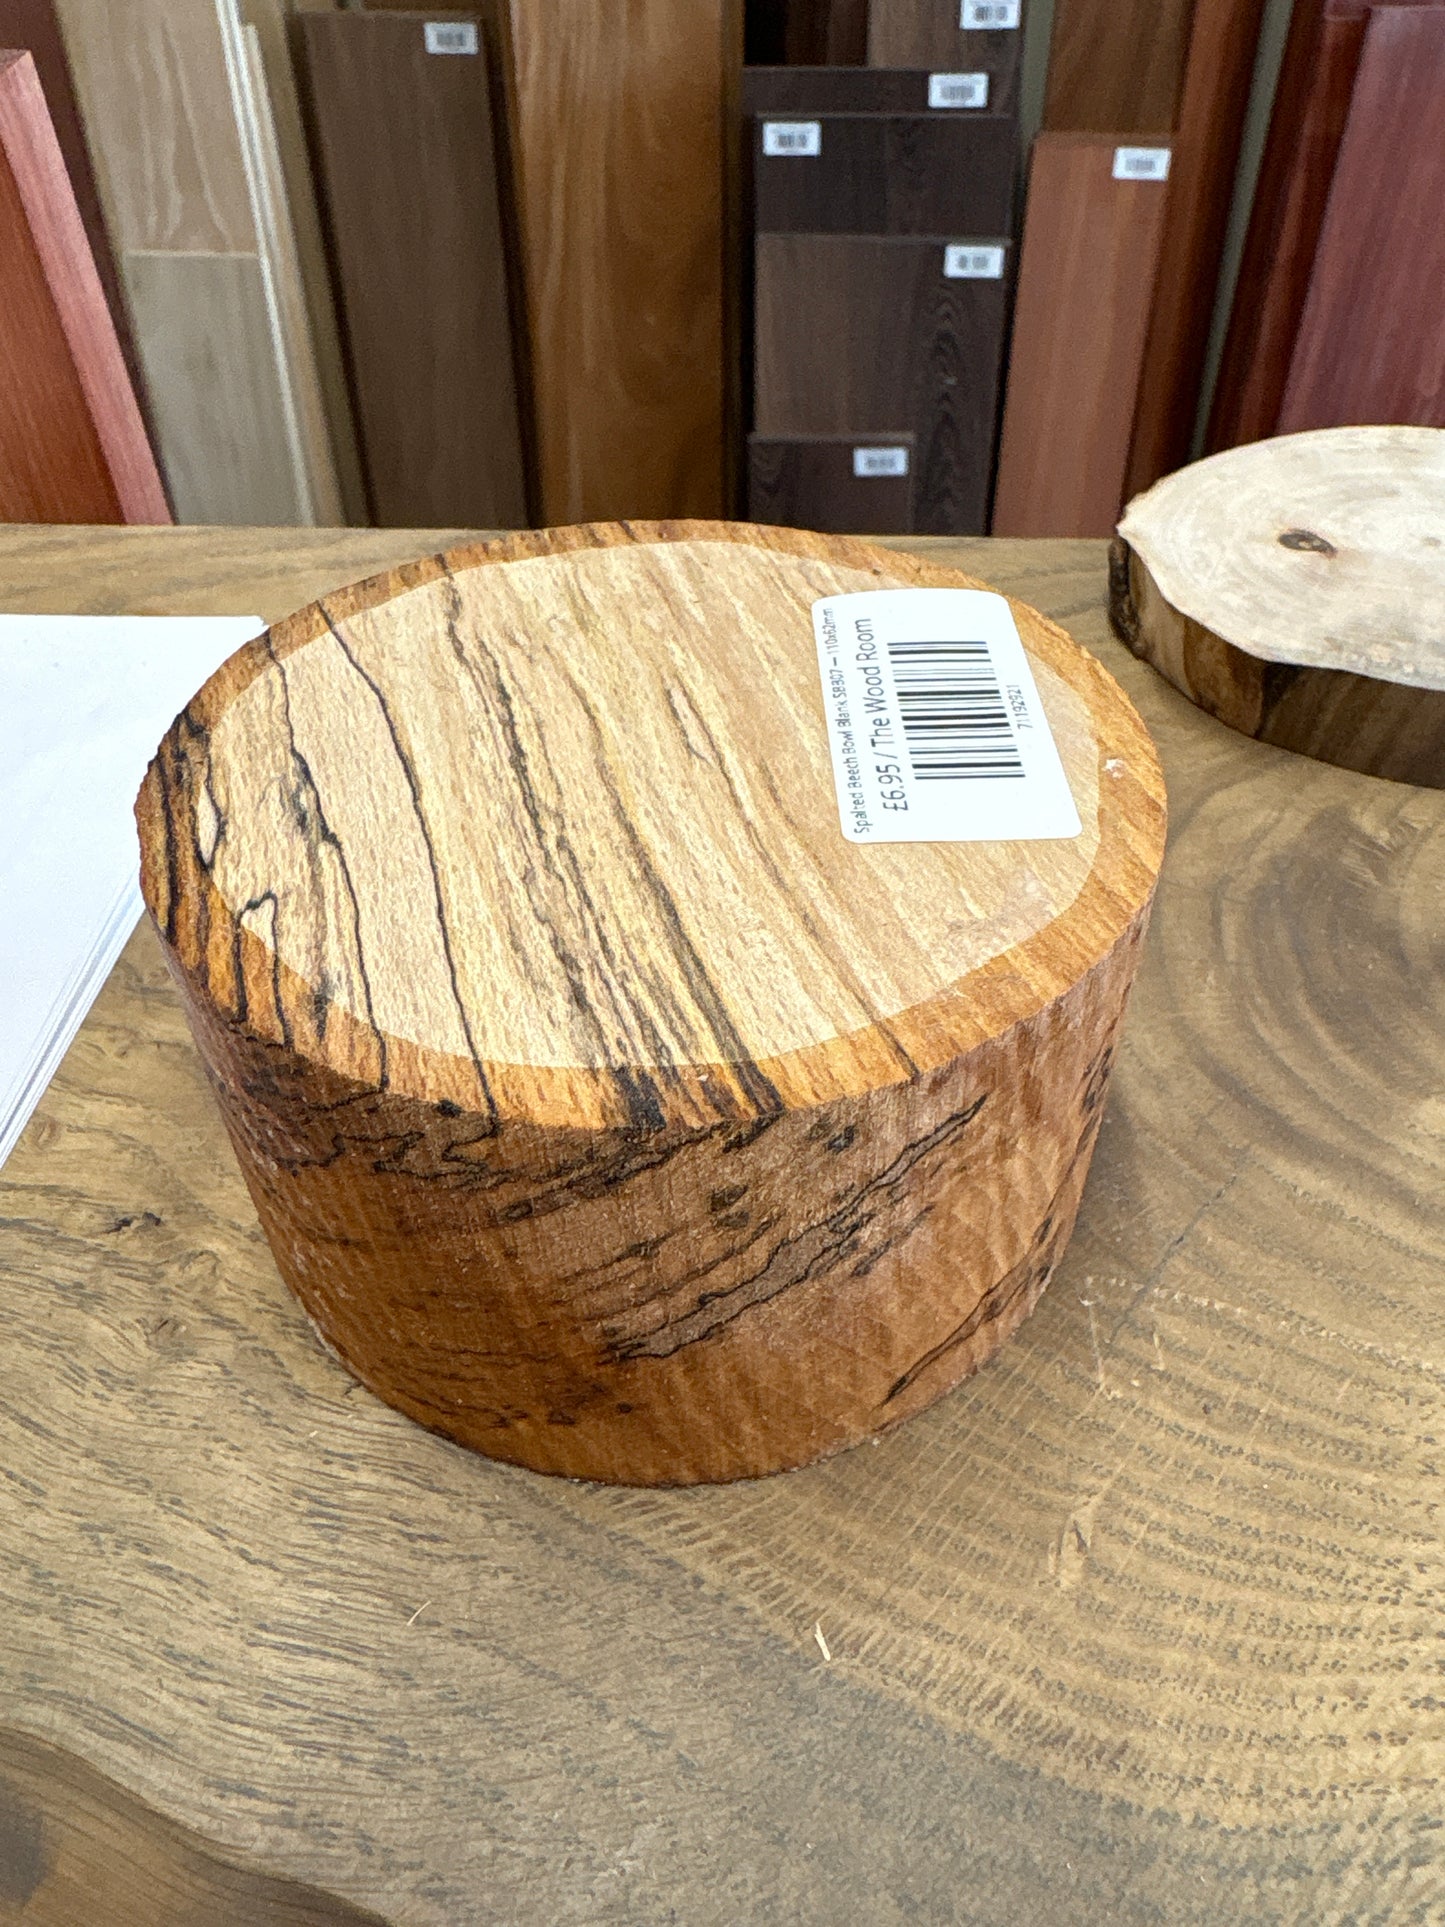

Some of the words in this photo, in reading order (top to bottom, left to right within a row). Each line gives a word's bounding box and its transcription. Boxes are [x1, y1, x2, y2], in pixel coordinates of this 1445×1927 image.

[822, 608, 840, 655] 110x62mm
[855, 618, 878, 660] Room
[829, 669, 847, 698] SB307
[857, 666, 888, 714] Wood
[834, 700, 851, 727] Blank
[1006, 685, 1033, 729] 71192921
[837, 731, 856, 754] Bowl
[868, 718, 895, 747] The
[843, 757, 862, 788] Beech
[875, 764, 909, 811] £6.95
[849, 792, 873, 834] Spalted
